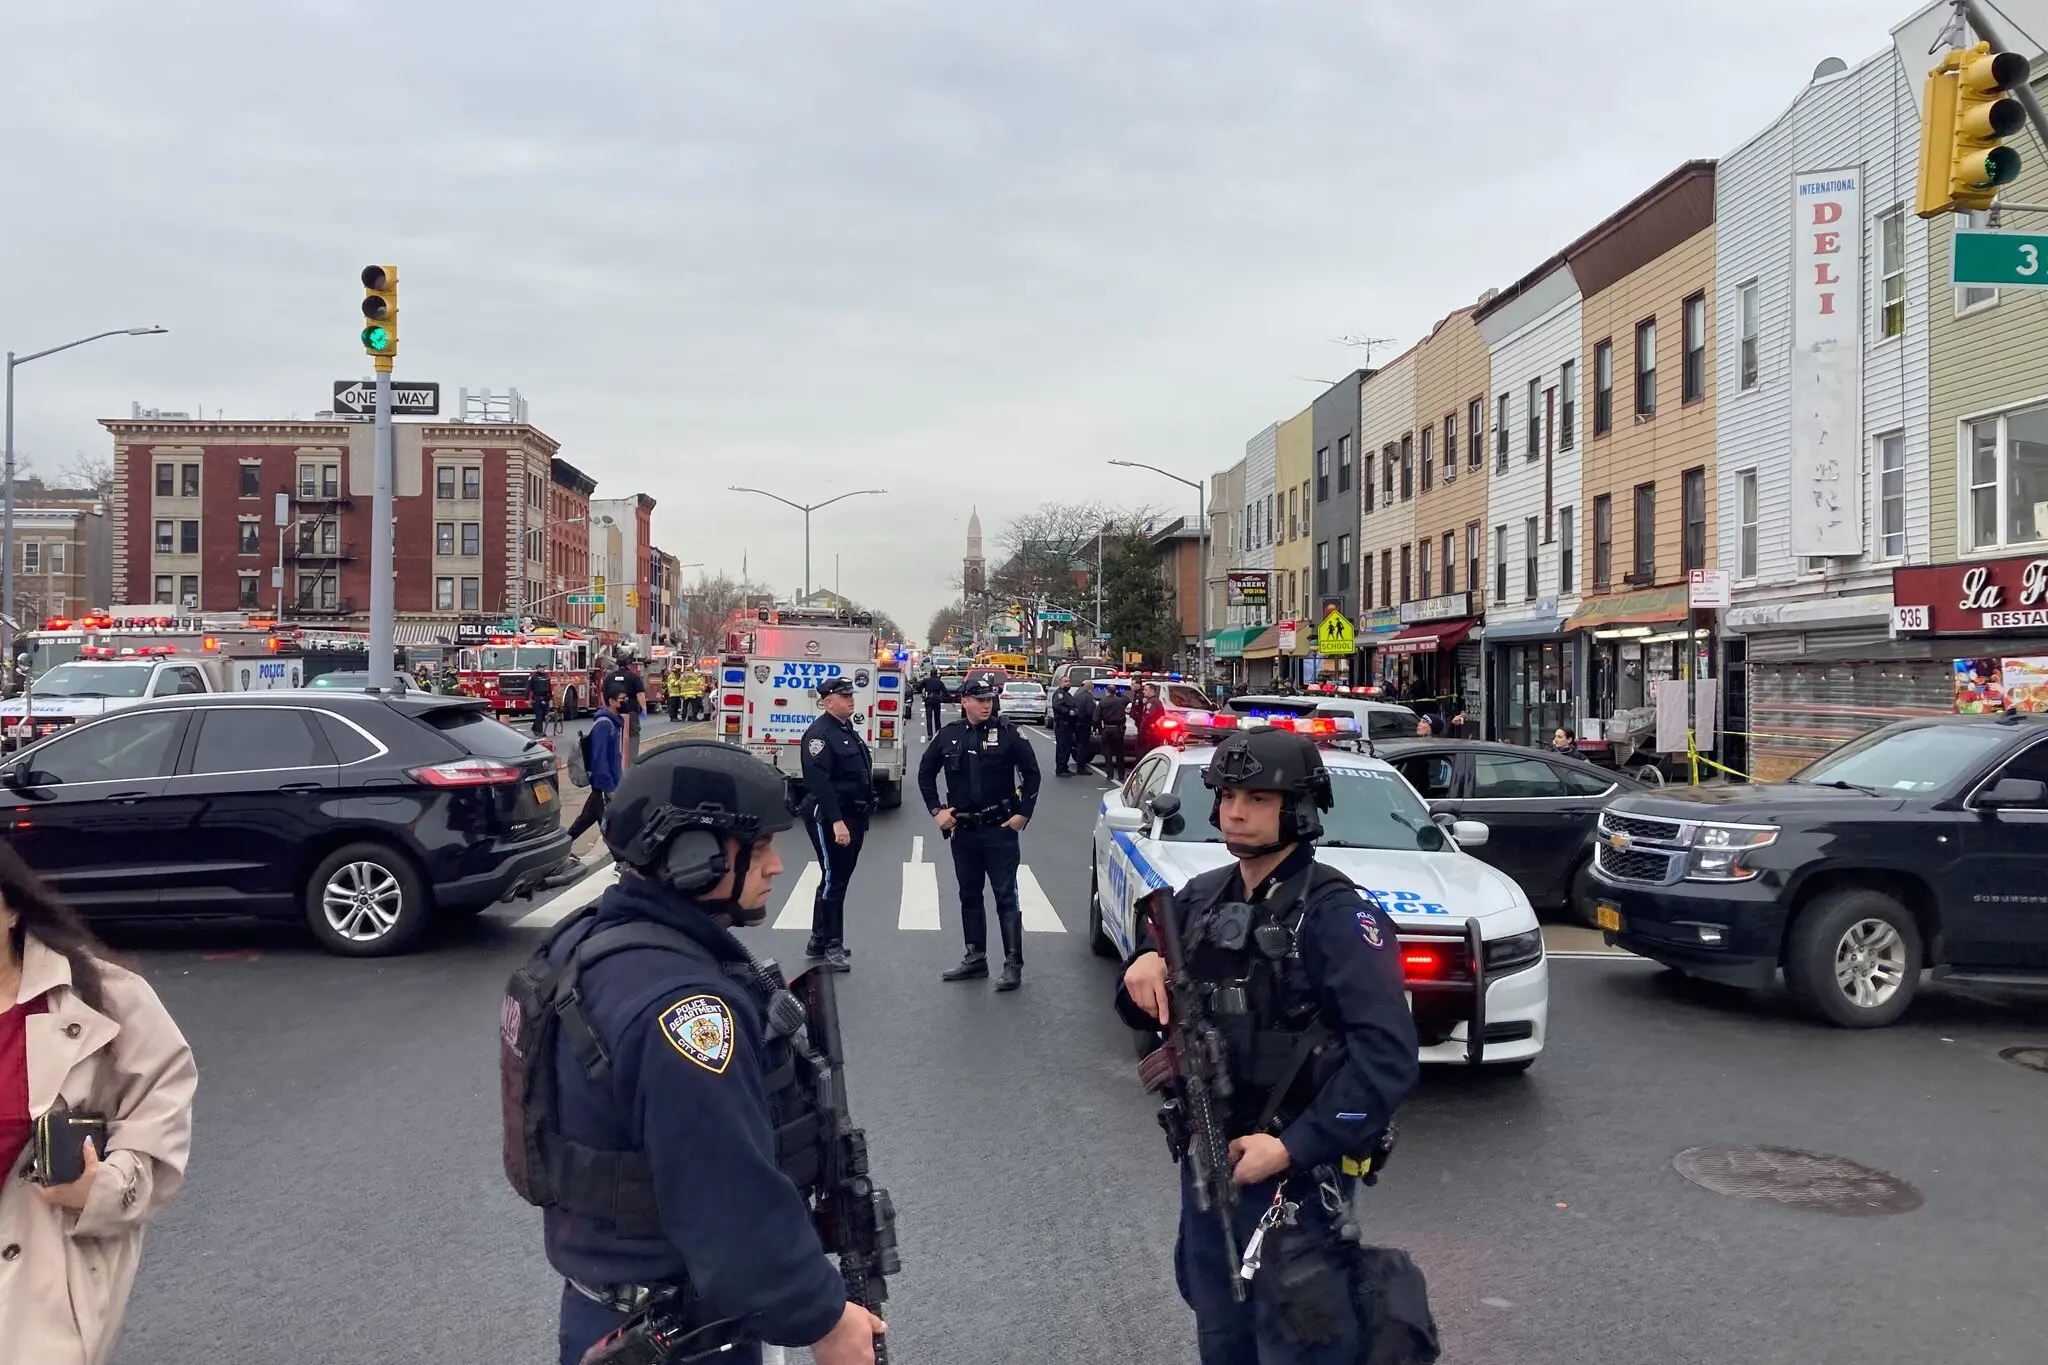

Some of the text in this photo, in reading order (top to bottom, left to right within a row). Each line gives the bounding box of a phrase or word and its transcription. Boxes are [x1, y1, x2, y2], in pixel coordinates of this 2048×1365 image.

[1800, 179, 1855, 195] INTERNATIONAL
[1812, 202, 1843, 315] DELI
[345, 391, 429, 405] ONE WAY
[1959, 559, 2048, 609] La F
[1900, 609, 1922, 628] 936
[460, 624, 482, 636] DELI
[57, 637, 81, 645] BLESS
[1321, 642, 1352, 650] SCHOOL
[259, 663, 286, 679] POLICE
[783, 663, 842, 677] NYPD
[773, 676, 824, 689] POLI
[504, 700, 517, 709] 114
[770, 713, 817, 724] EMERGENCY
[1324, 767, 1385, 780] ATROL
[700, 815, 714, 825] 382
[1361, 890, 1422, 901] PD
[1973, 894, 2048, 903] SUBURBAN
[1373, 901, 1449, 914] ICE
[676, 998, 708, 1016] POLICE
[669, 1005, 722, 1032] DEPARTMENT
[677, 1017, 731, 1063] CITY OF NEW YORK
